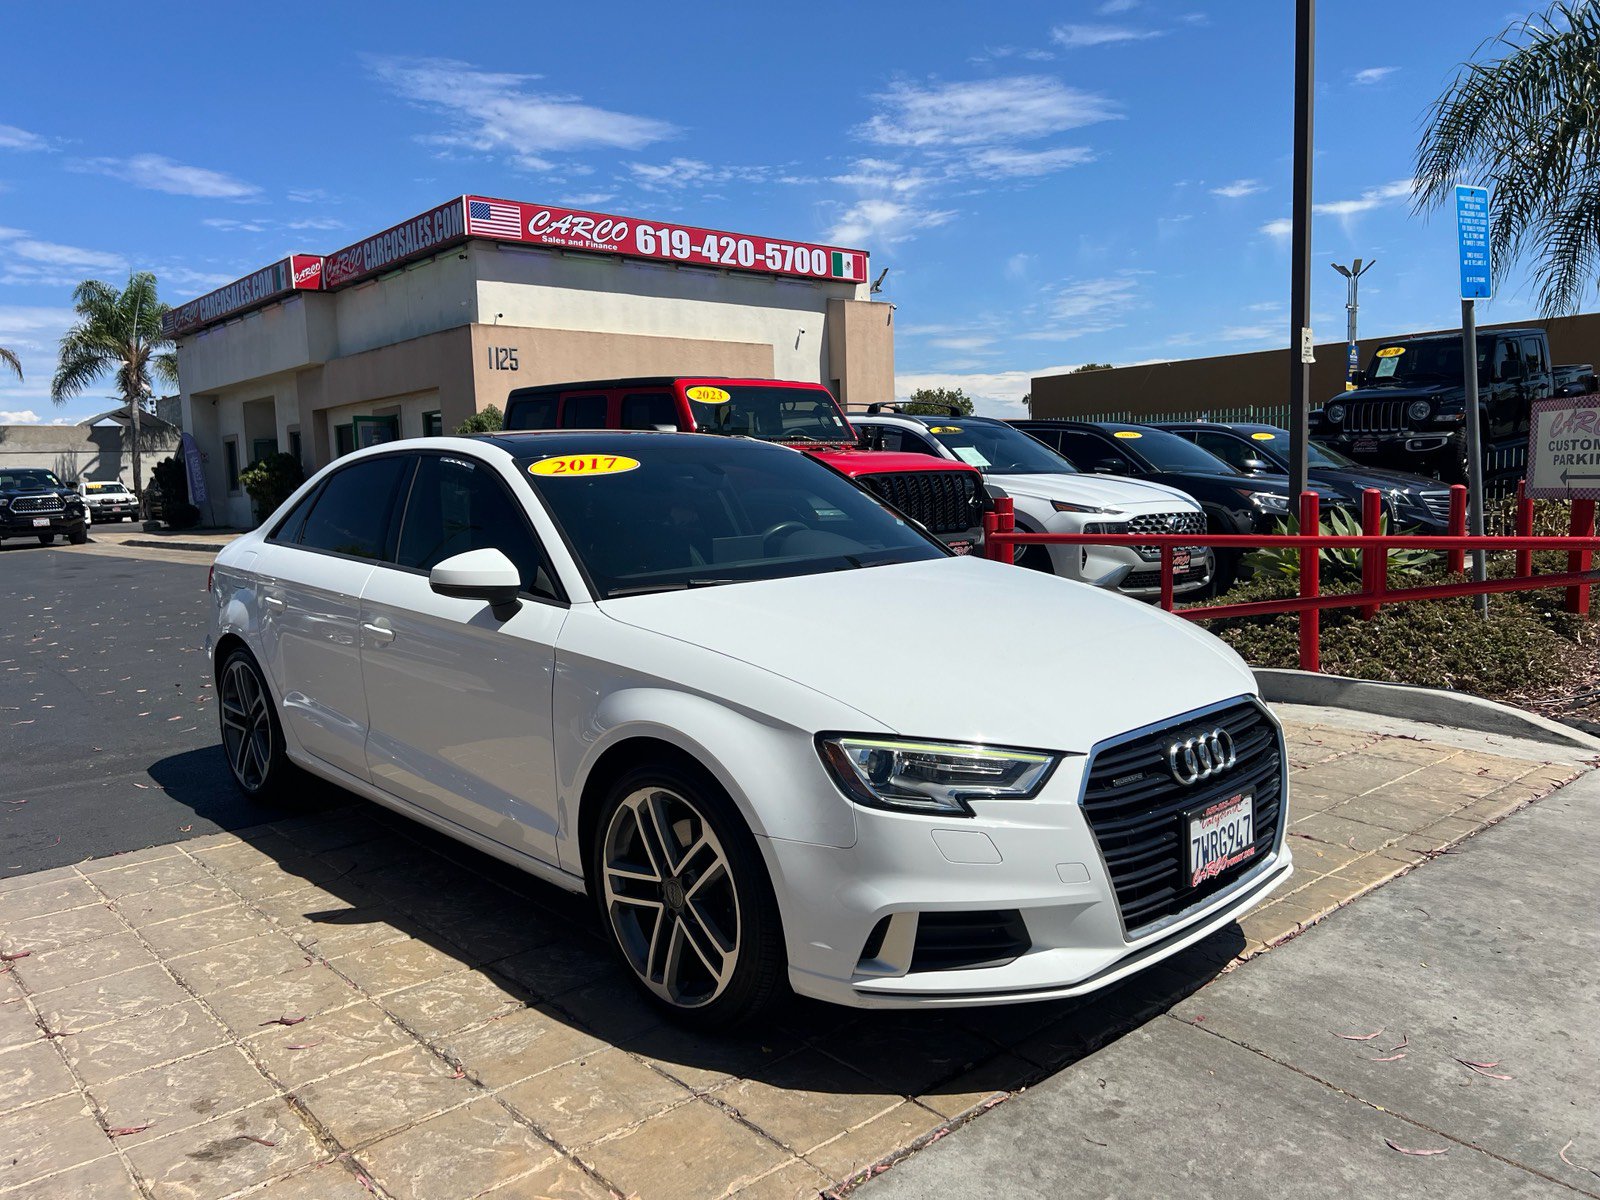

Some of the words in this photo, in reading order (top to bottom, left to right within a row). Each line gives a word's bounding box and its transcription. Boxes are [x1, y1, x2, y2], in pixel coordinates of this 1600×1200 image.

[363, 201, 463, 271] CARCOSALES.COM
[527, 209, 630, 244] CARCO
[541, 235, 566, 245] Sales
[568, 239, 583, 247] and
[585, 240, 618, 251] Finance
[635, 224, 827, 276] 619-420-5700
[294, 262, 321, 282] CARCO
[326, 247, 362, 282] CARCO
[199, 268, 274, 321] CARCOSALES.COM
[488, 346, 519, 371] 1125
[696, 390, 723, 400] 2023
[551, 457, 618, 475] 2017
[1553, 453, 1600, 466] PARKI
[1192, 814, 1251, 869] 7WRG947
